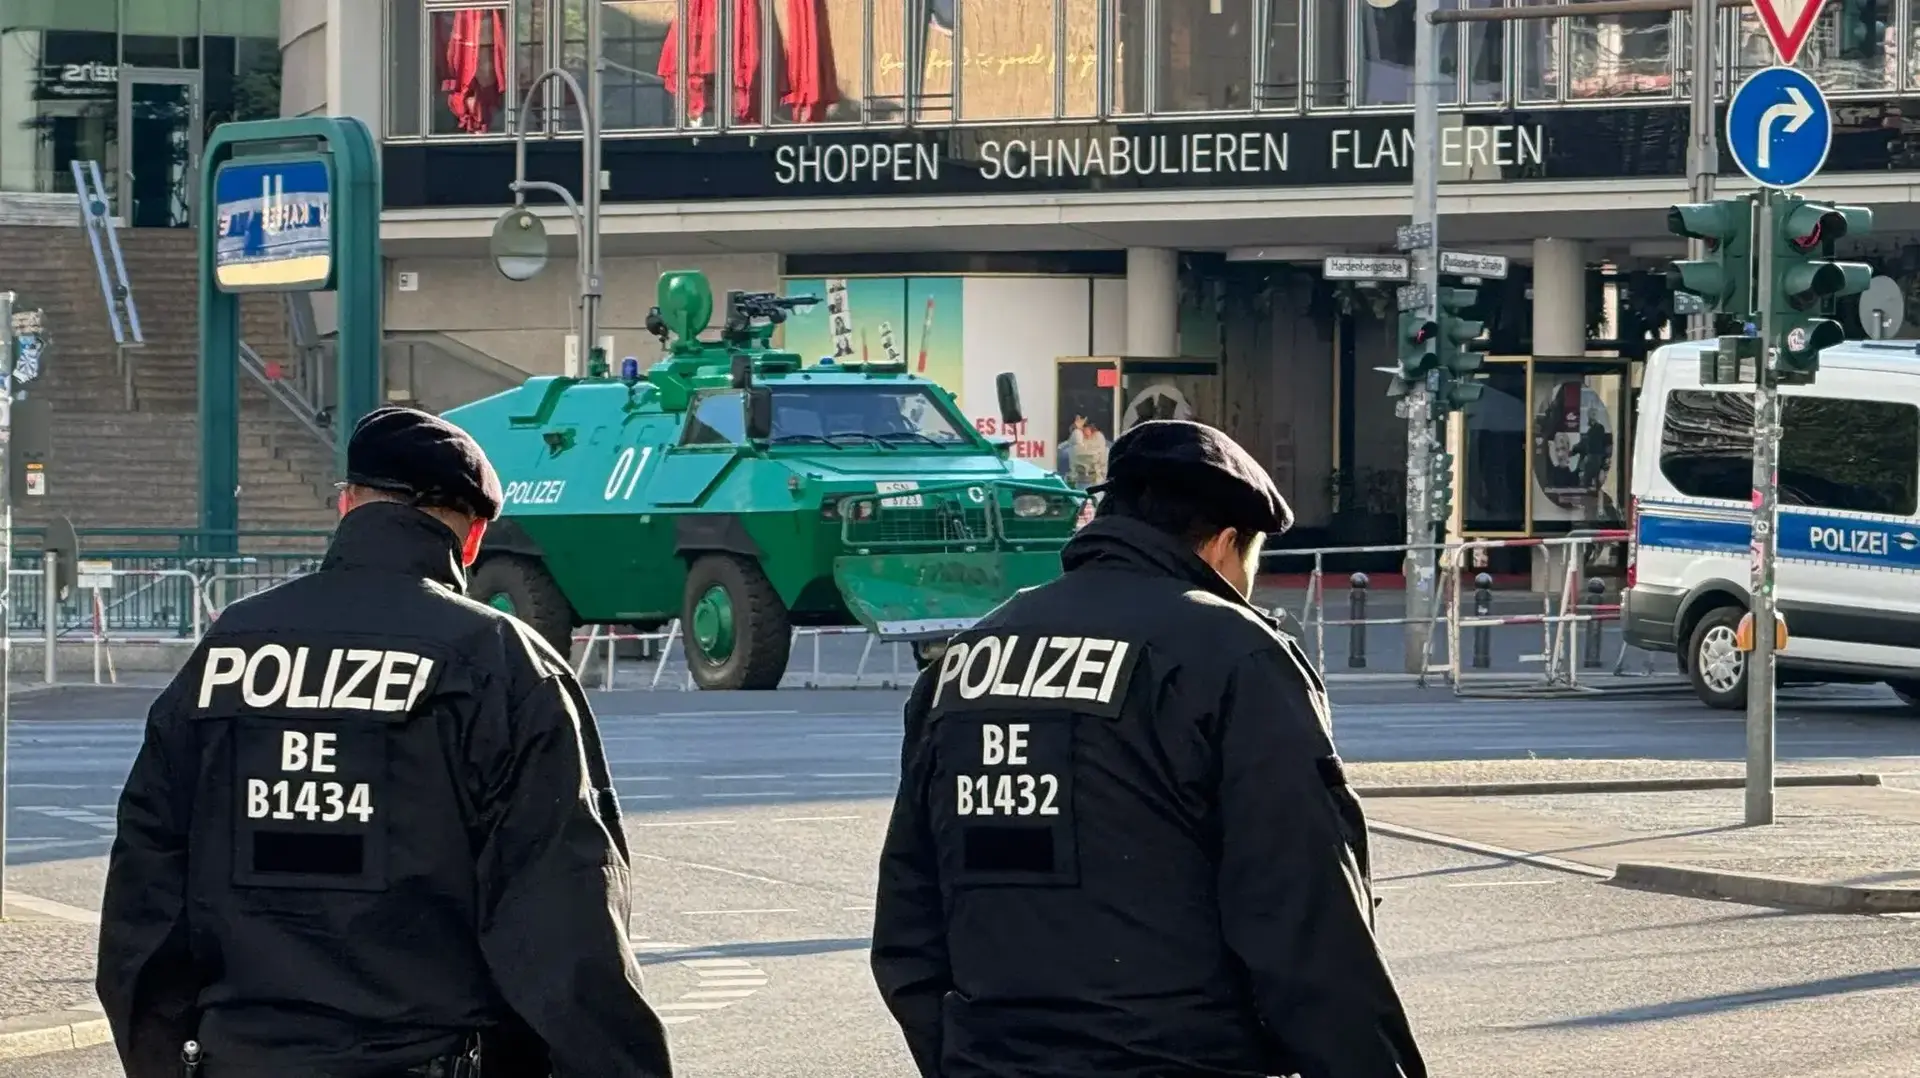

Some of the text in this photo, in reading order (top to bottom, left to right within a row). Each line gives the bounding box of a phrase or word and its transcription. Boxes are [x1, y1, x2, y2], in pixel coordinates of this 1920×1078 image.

[775, 124, 1543, 184] SHOPPEN SCHNABULIEREN FLANEREN
[976, 418, 996, 435] ES
[504, 480, 566, 504] POLIZEI
[604, 447, 652, 500] 01
[1810, 526, 1888, 555] POLIZEI
[198, 643, 434, 712] POLIZEI
[931, 635, 1130, 709] POLIZEI
[281, 730, 337, 773] BE
[982, 724, 1030, 765] BE
[247, 779, 374, 822] B1434
[956, 774, 1060, 816] B1432
